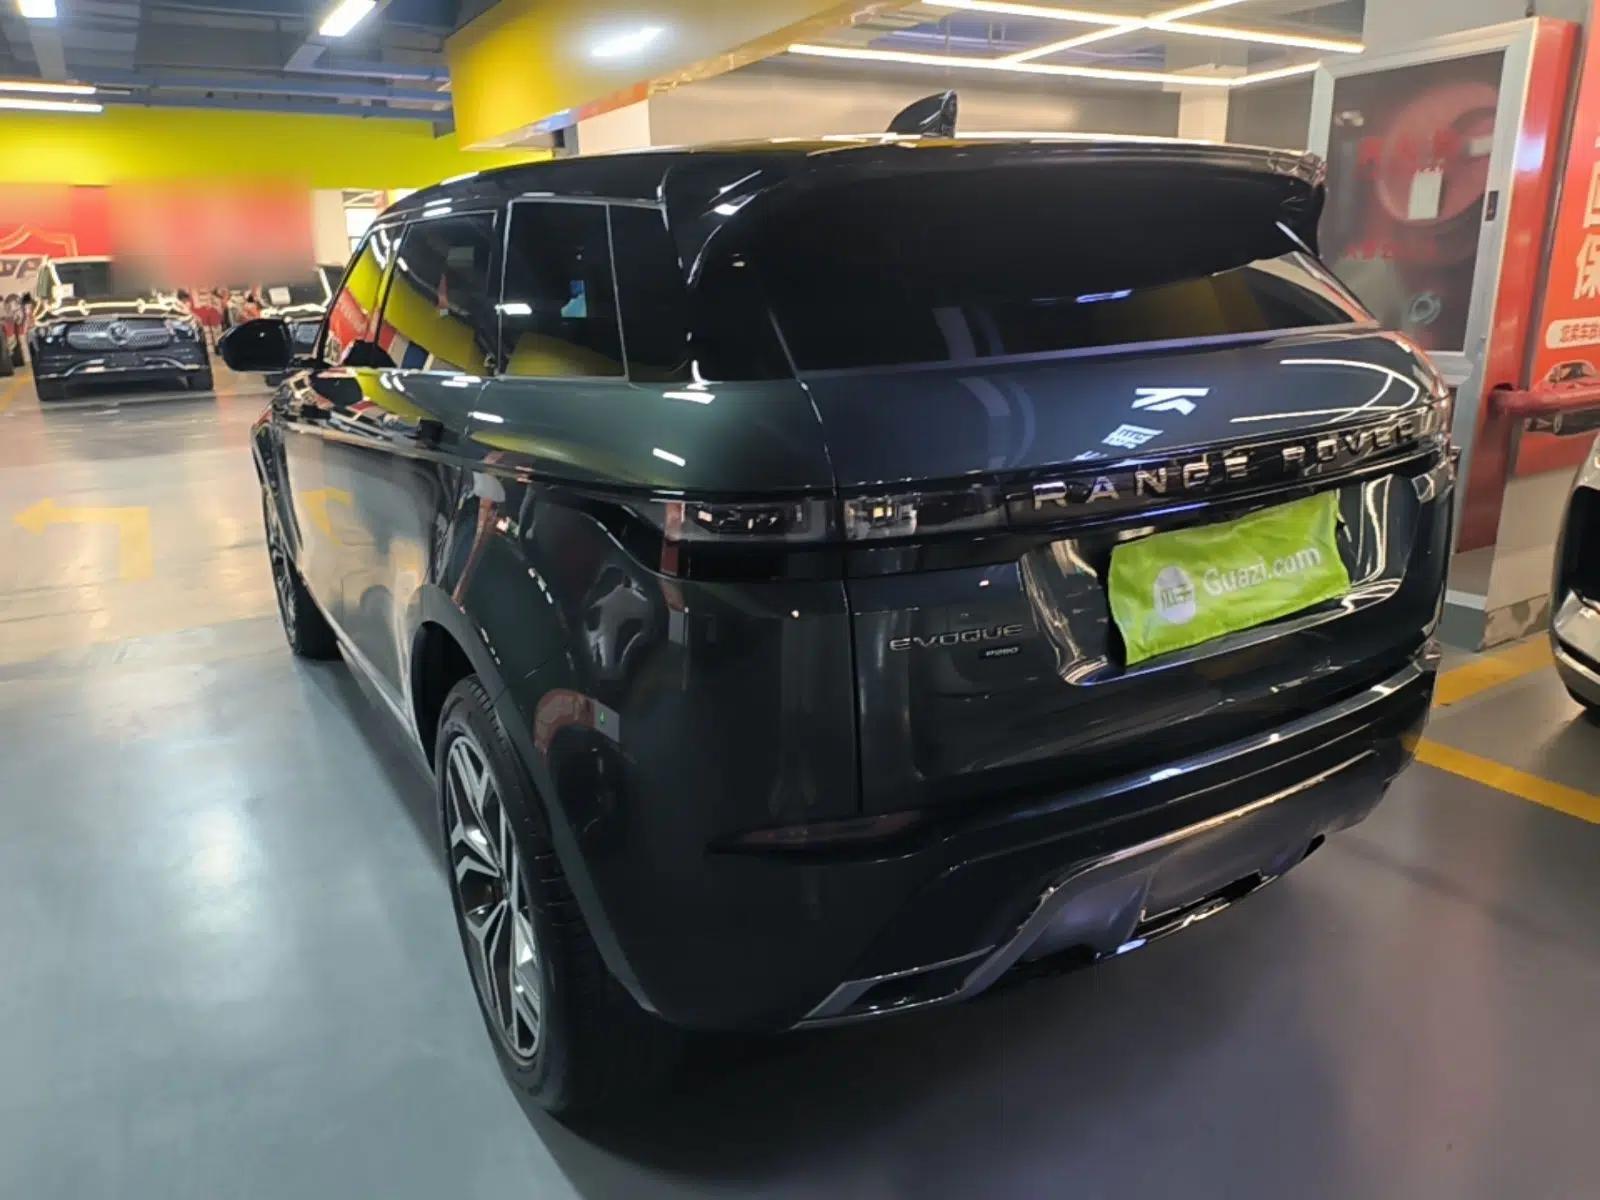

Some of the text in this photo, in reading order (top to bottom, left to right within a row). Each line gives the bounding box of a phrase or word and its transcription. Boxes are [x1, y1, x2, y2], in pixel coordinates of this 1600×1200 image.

[1032, 419, 1415, 511] RANGE ROVER
[1203, 548, 1322, 596] Guazi.com
[890, 624, 1023, 650] EVOQUE
